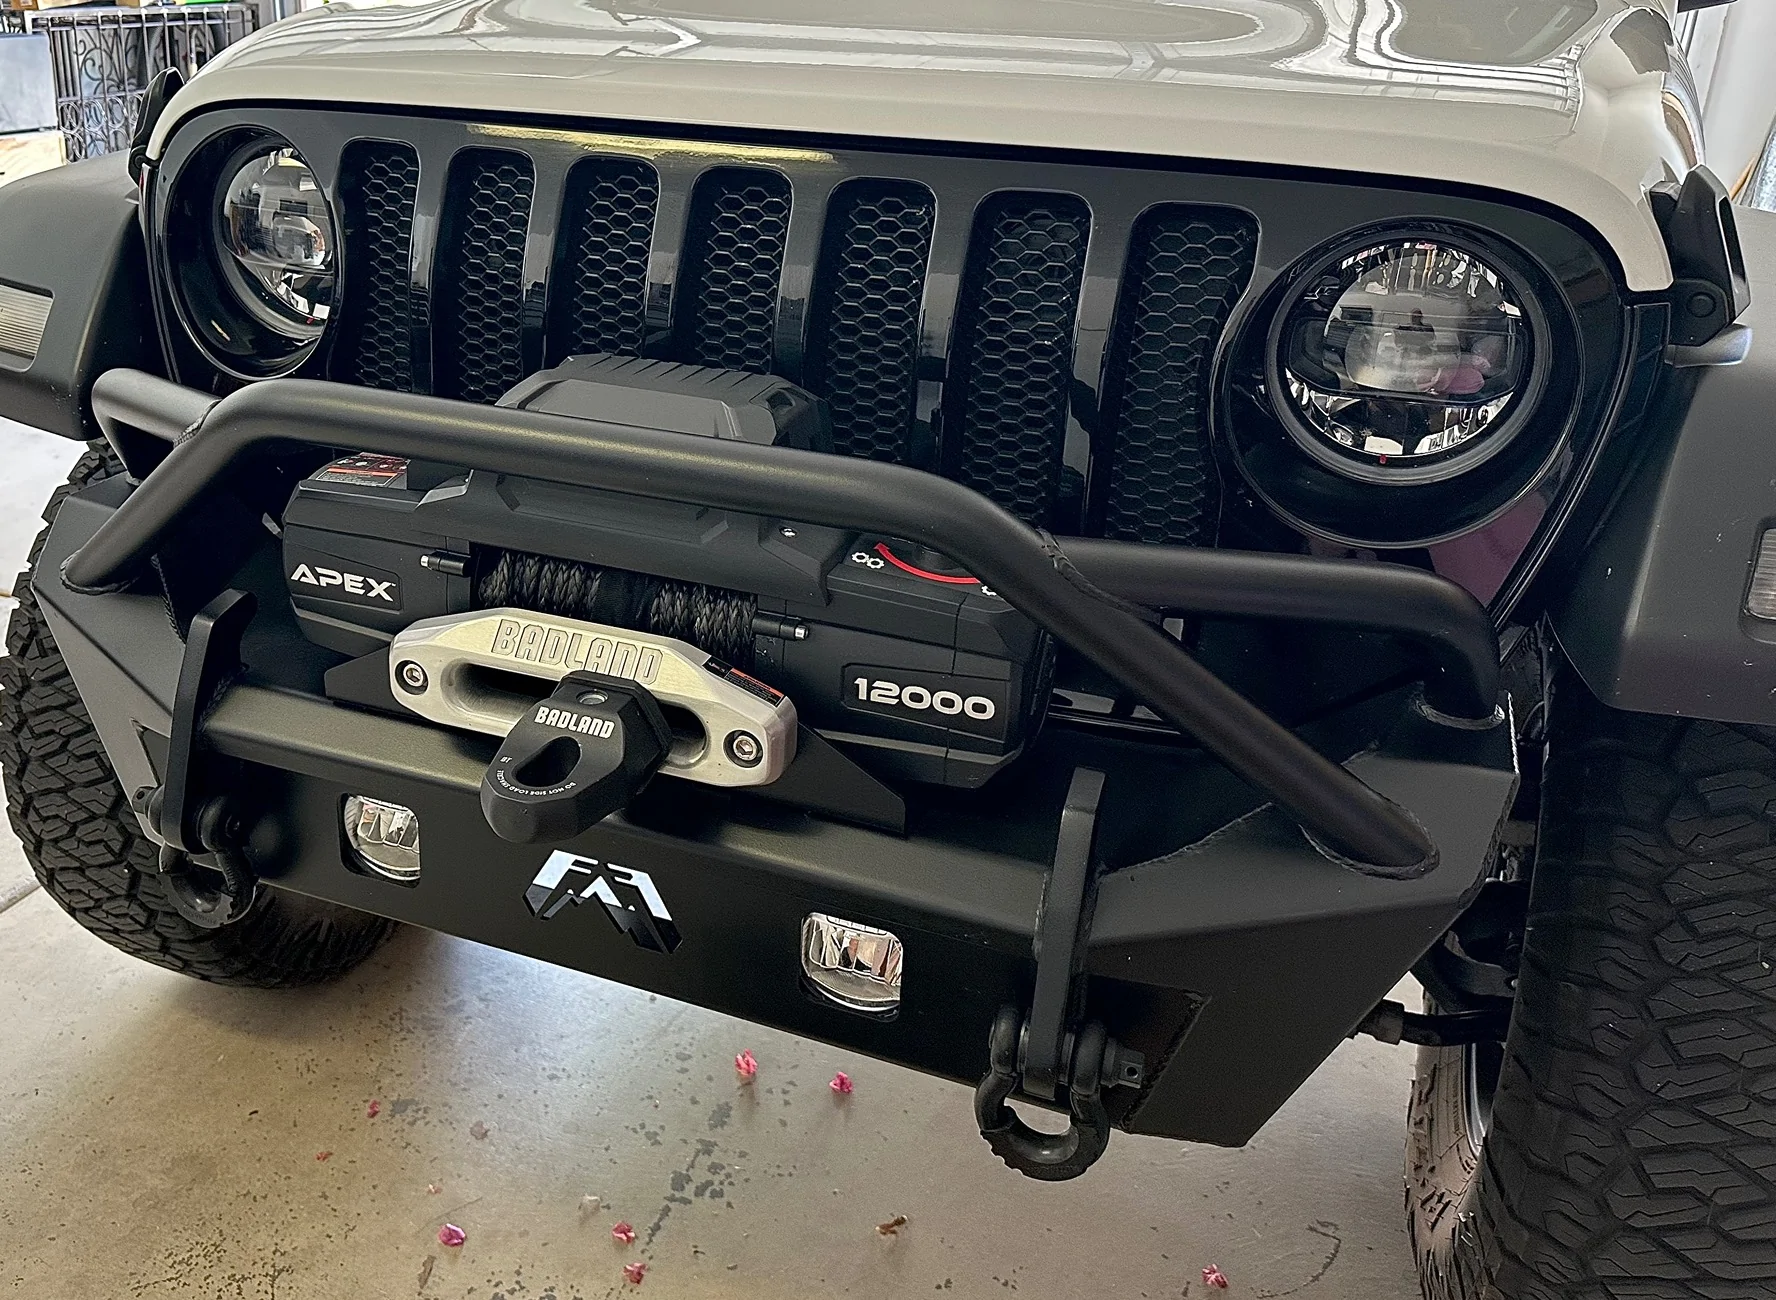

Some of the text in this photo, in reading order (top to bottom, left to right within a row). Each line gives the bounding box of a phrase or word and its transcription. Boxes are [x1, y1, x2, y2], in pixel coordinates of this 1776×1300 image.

[290, 563, 394, 602] APEX
[491, 619, 664, 685] BADLAND
[853, 677, 995, 720] 12000
[534, 706, 615, 739] BADLAND
